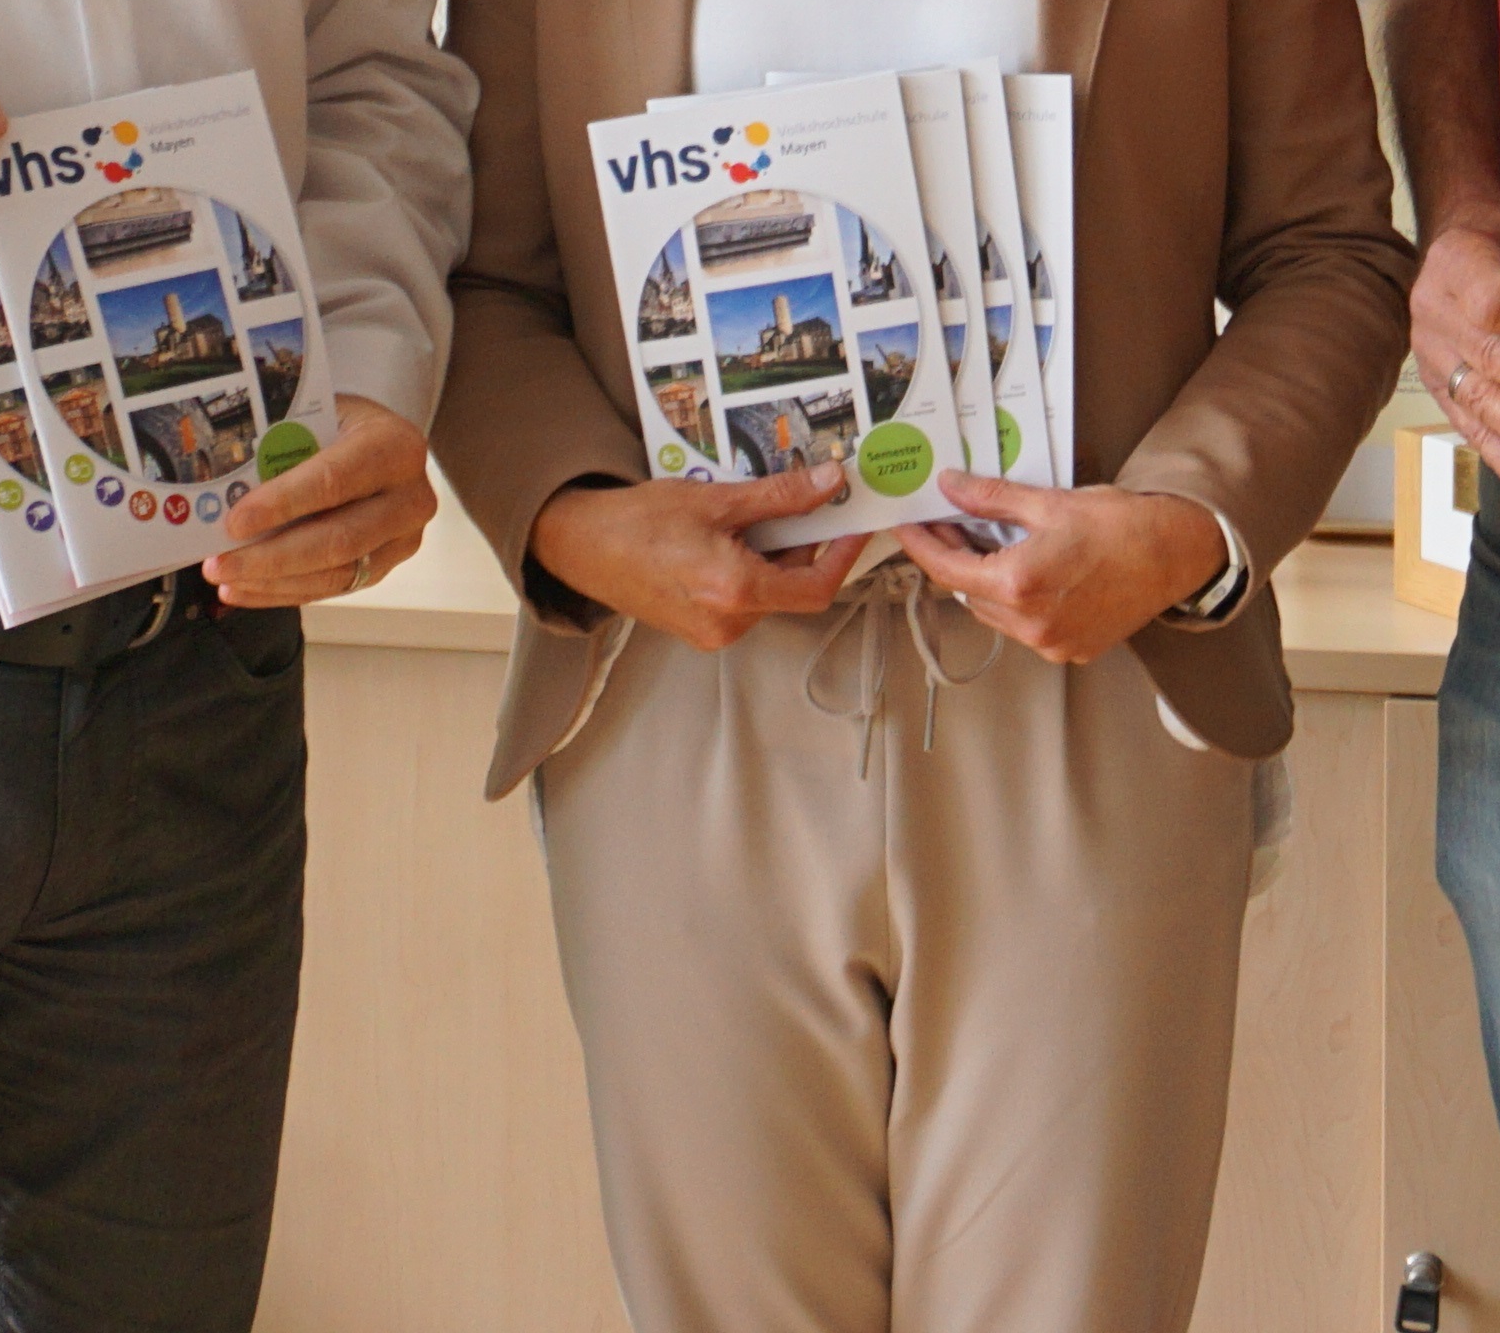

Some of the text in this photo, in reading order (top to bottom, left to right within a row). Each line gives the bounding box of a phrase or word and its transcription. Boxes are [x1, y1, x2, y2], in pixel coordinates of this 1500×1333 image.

[150, 137, 195, 154] Mayen
[780, 138, 827, 157] Mayen
[607, 139, 711, 193] vhs
[867, 444, 922, 462] Semester
[877, 459, 918, 477] 2/2023
